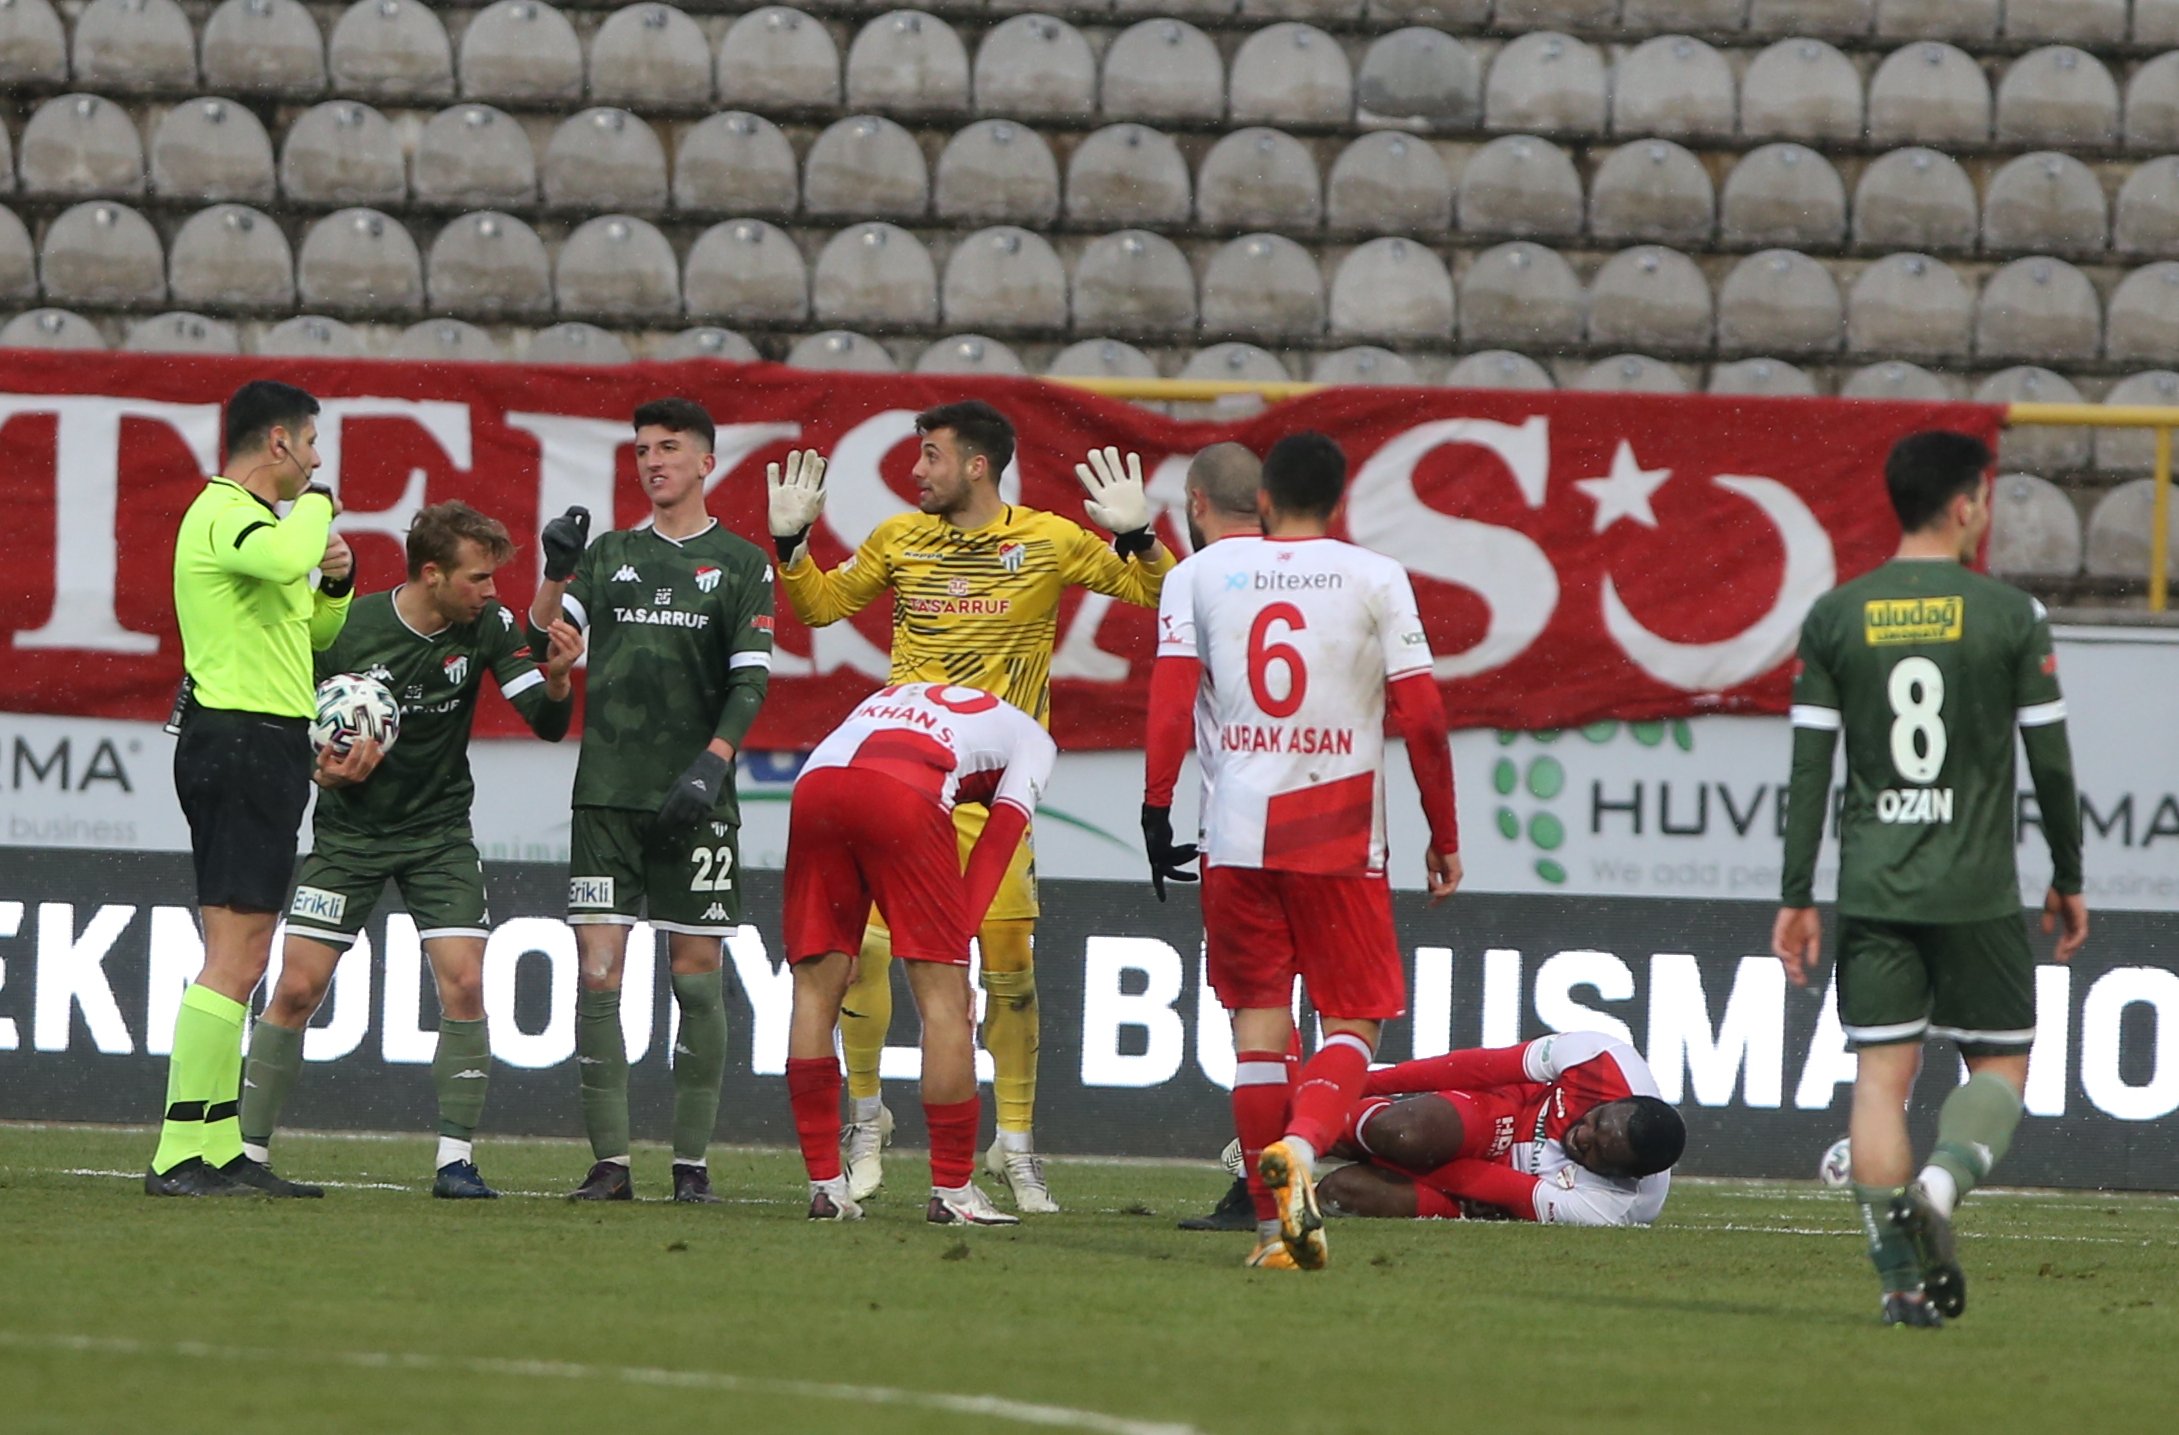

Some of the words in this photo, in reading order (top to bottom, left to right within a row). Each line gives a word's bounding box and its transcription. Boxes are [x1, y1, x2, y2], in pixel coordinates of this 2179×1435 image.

[1254, 571, 1342, 590] bitexen
[613, 608, 710, 629] TASARRUF
[911, 599, 1010, 614] TASARRUF
[1247, 601, 1308, 718] 6
[1887, 656, 1948, 784] 8
[1287, 727, 1354, 754] ASAN
[1876, 787, 1954, 824] OZAN
[690, 846, 733, 891] 22
[293, 890, 341, 919] Erikli
